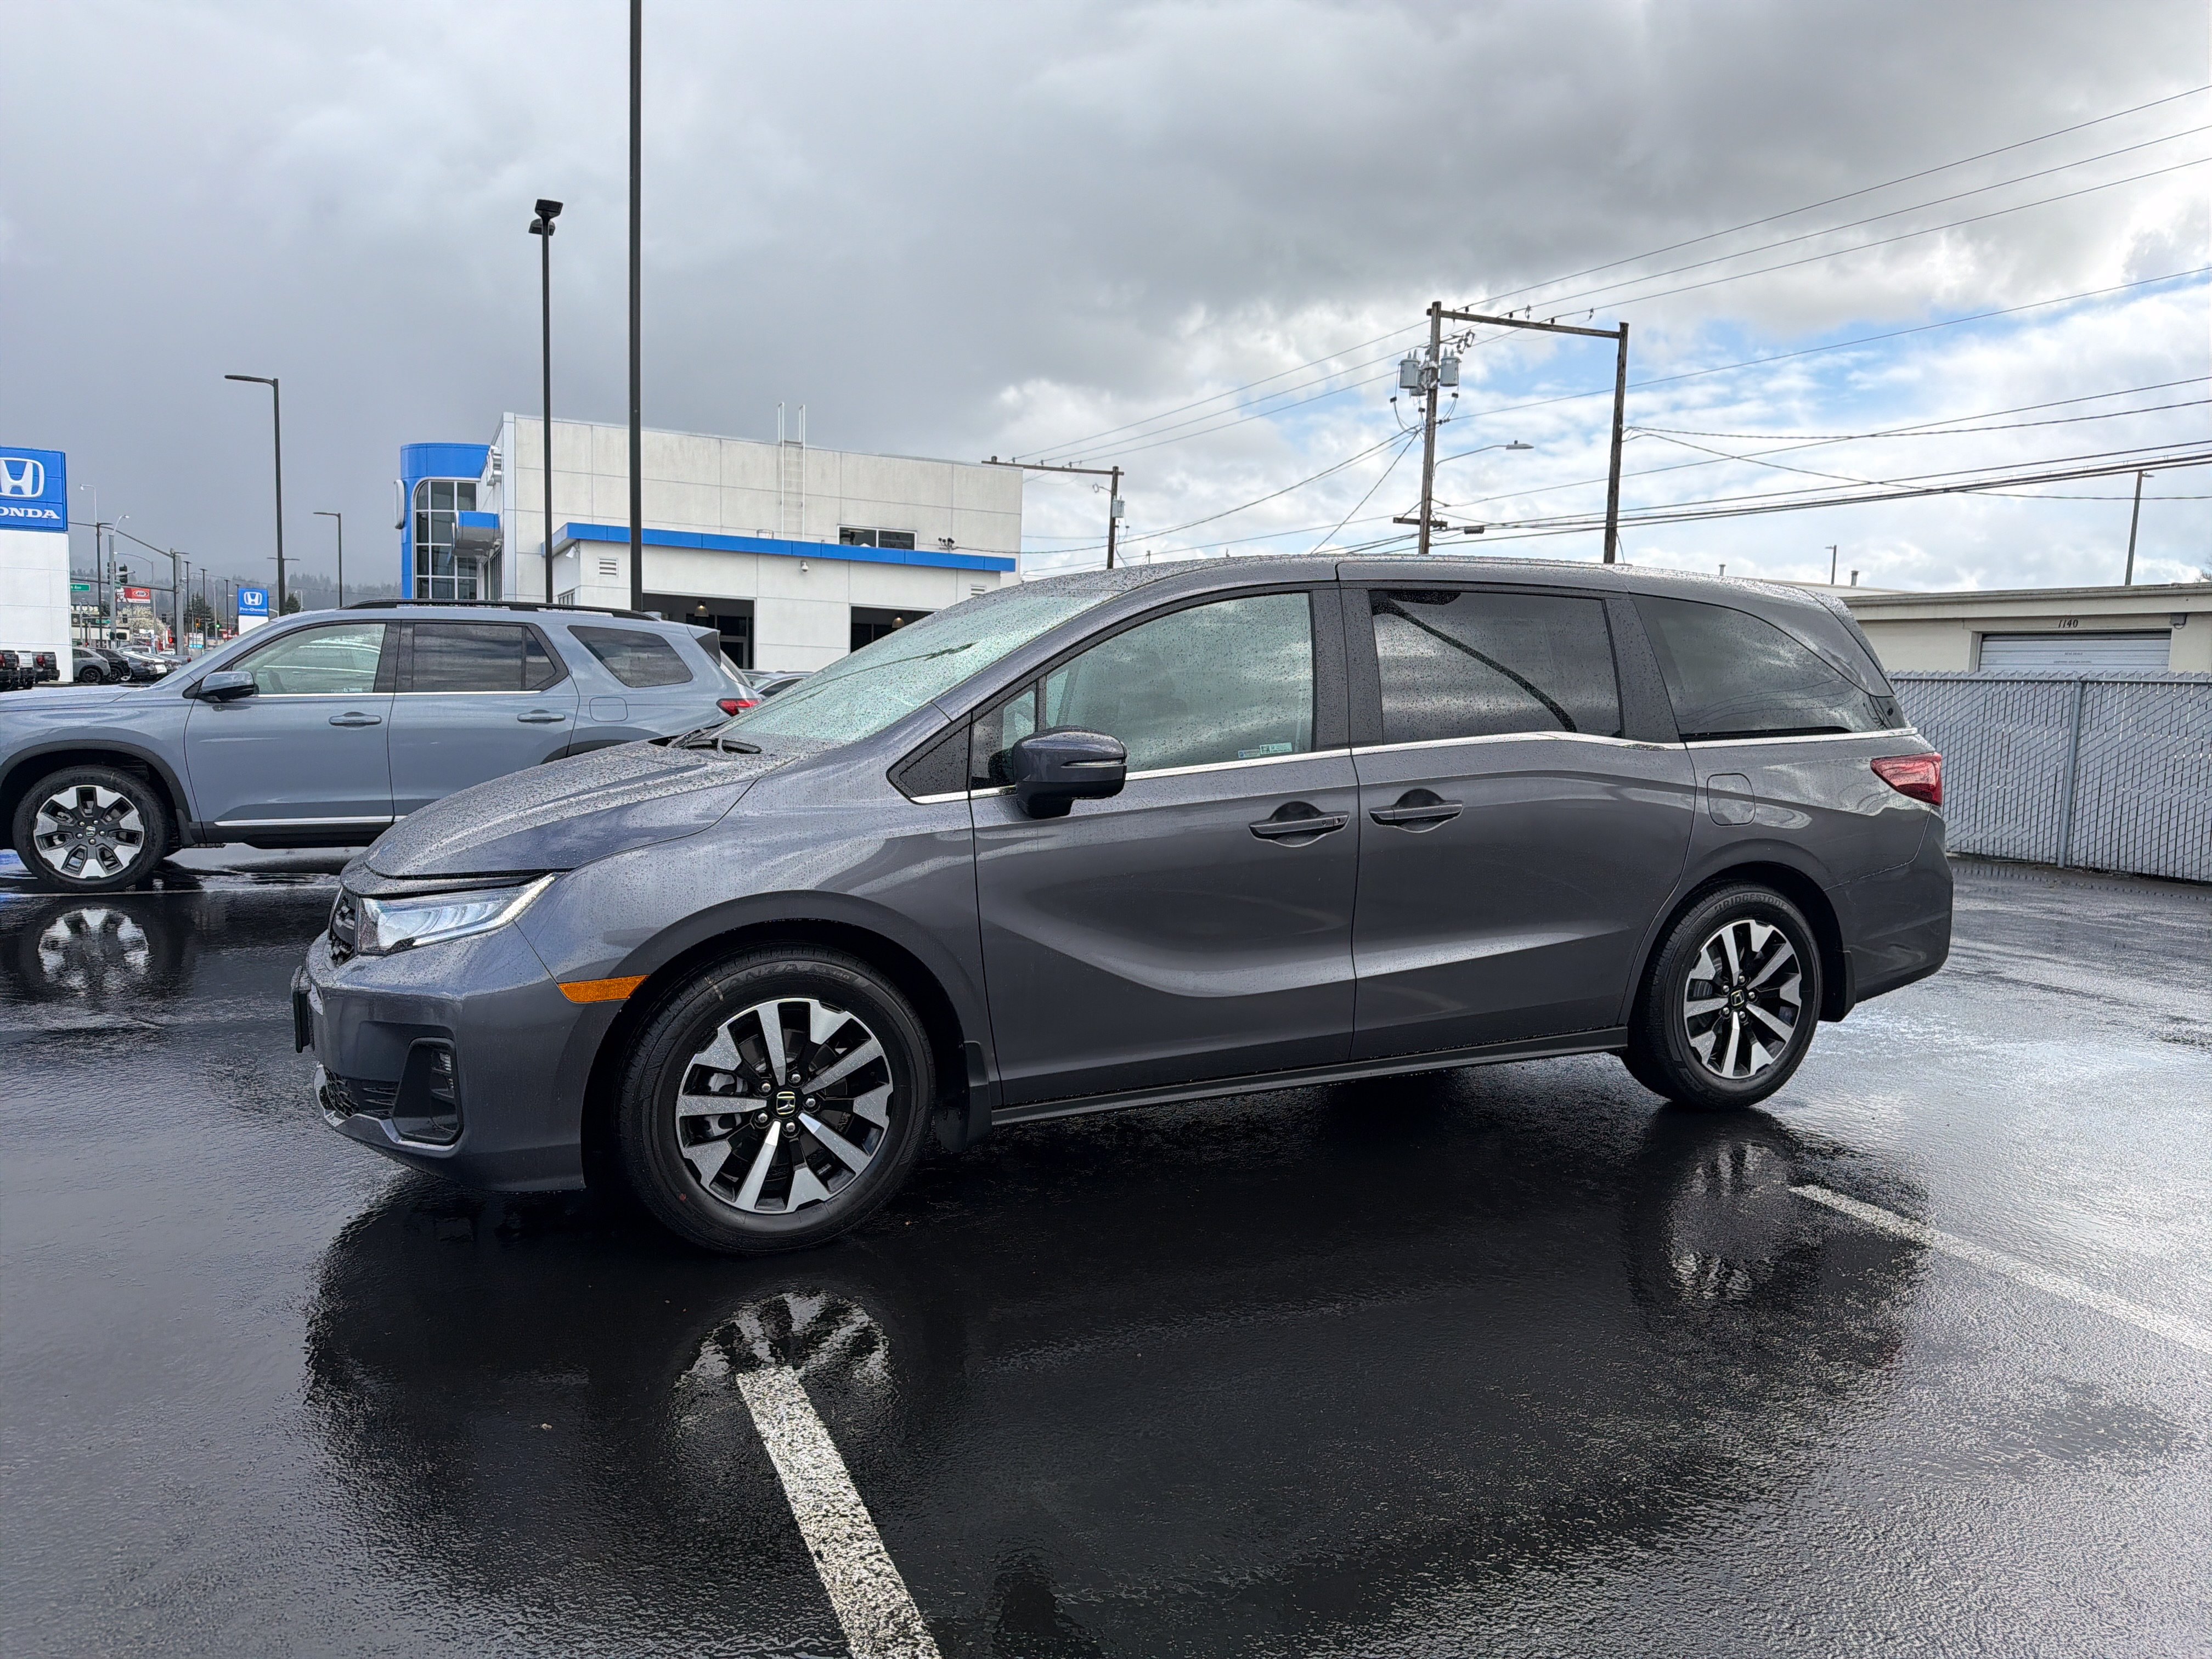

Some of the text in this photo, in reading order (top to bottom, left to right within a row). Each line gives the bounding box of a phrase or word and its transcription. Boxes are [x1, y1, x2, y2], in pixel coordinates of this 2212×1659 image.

[0, 506, 61, 519] ONDA
[2058, 618, 2079, 628] 1140
[1713, 893, 1787, 913] BRIDGESTONE
